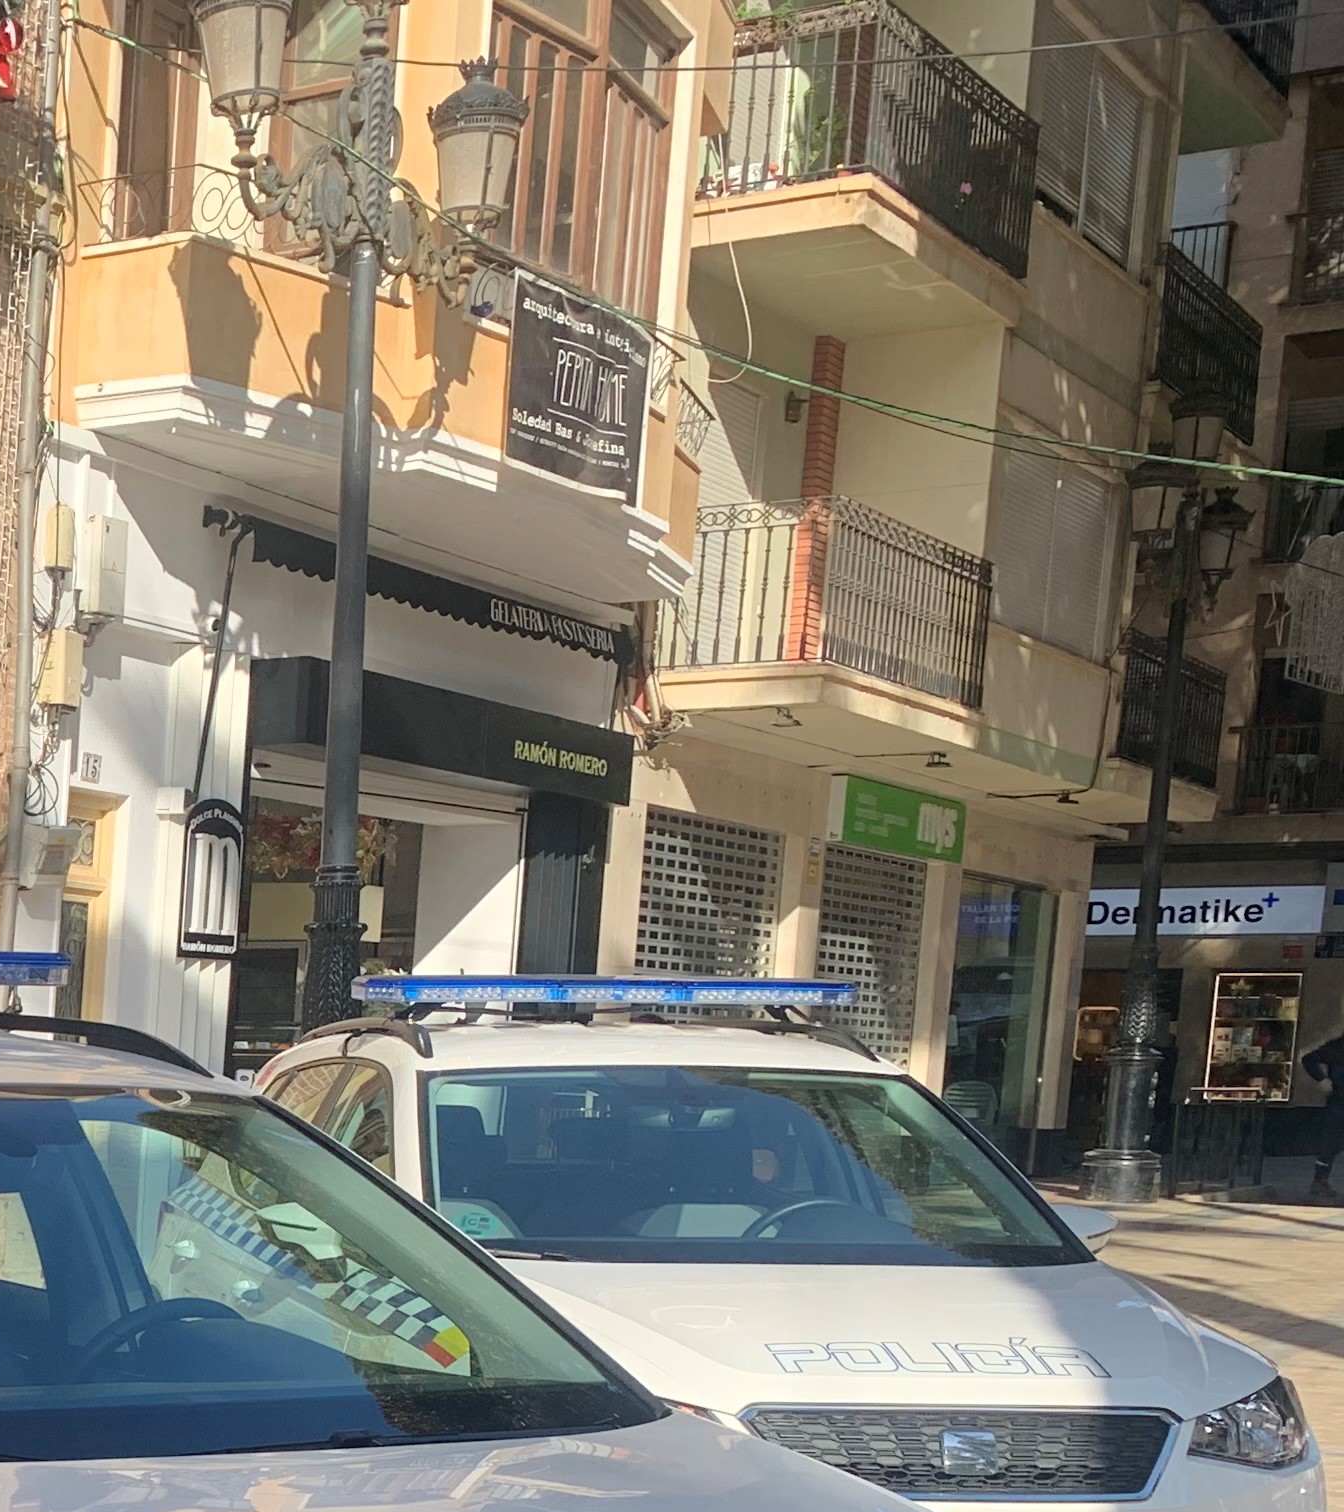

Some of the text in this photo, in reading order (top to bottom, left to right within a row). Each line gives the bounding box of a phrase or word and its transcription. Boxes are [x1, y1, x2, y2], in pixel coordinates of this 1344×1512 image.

[512, 407, 552, 432] Soledad
[555, 422, 572, 440] Bas
[84, 758, 98, 780] 15
[514, 740, 608, 777] RAMÓN ROMERO
[764, 1336, 1112, 1379] POLICÍA
